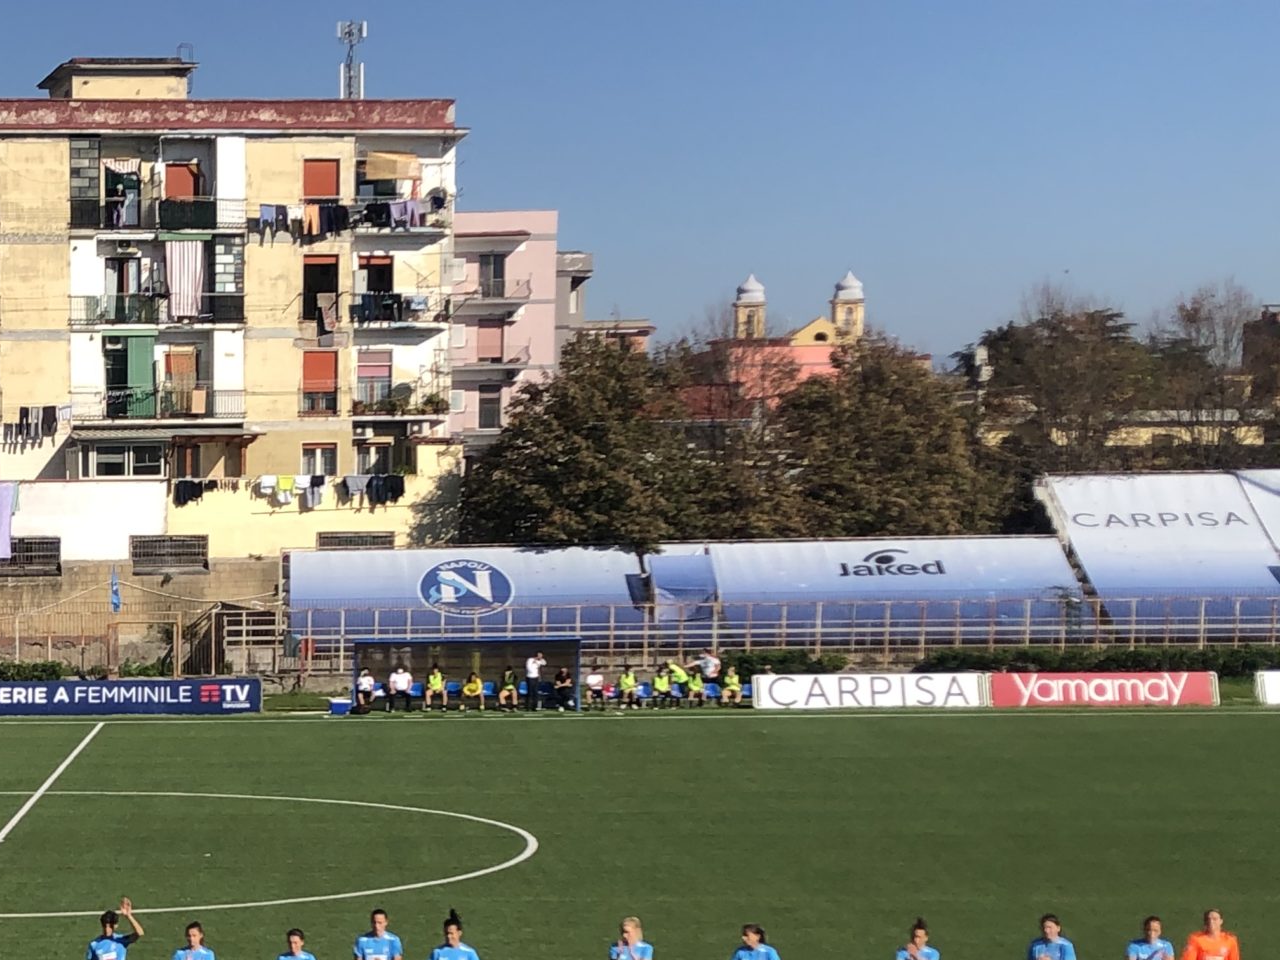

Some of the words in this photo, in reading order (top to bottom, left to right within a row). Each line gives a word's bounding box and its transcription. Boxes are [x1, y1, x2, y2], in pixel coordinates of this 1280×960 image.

[1071, 511, 1250, 528] CARPISA
[438, 560, 492, 571] NAPOLI
[53, 686, 70, 704] A
[74, 685, 193, 704] FEMMINILE
[221, 684, 250, 702] TV
[767, 675, 971, 706] CARPISA
